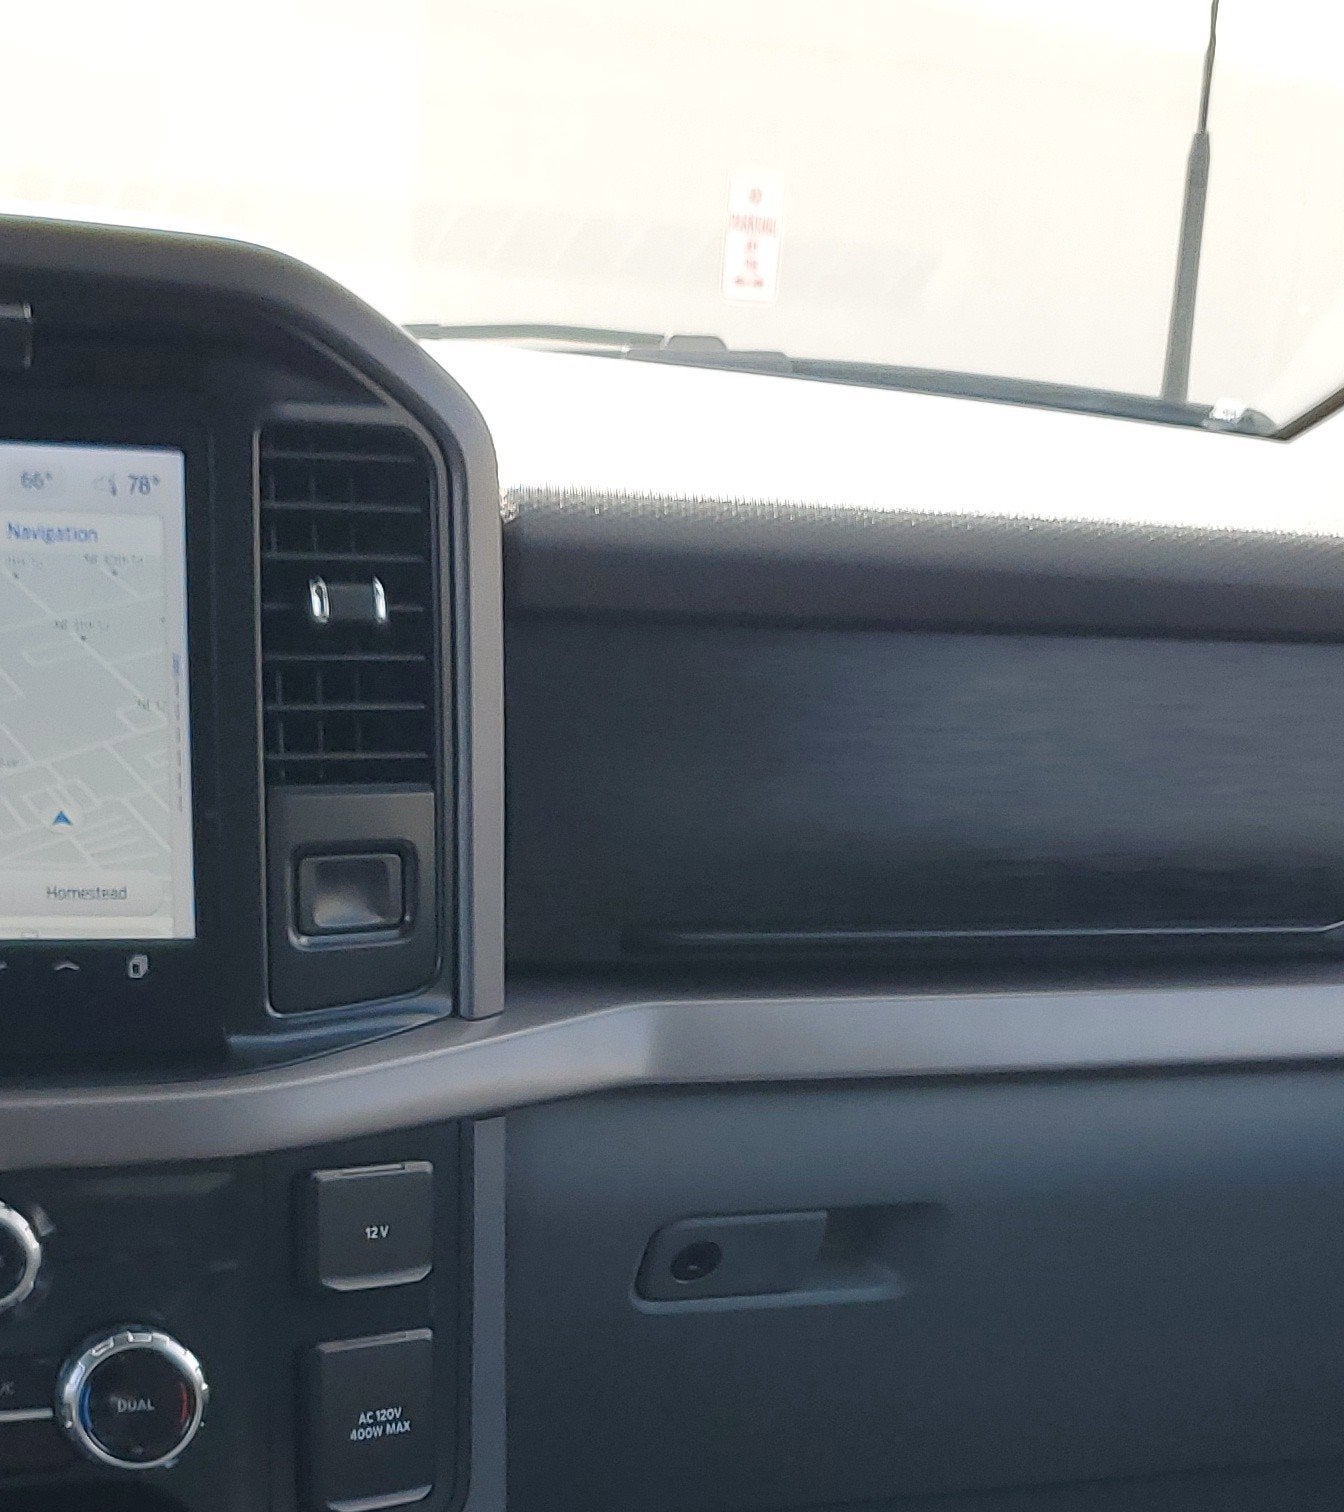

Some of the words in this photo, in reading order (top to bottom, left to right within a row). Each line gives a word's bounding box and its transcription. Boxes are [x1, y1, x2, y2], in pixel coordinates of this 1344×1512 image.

[6, 522, 99, 544] Navigation
[45, 884, 128, 901] Homestead
[116, 1398, 155, 1413] DUAL
[358, 1411, 374, 1426] AC
[375, 1405, 402, 1422] 120V
[349, 1424, 384, 1442] 400W
[385, 1420, 411, 1437] MAX
